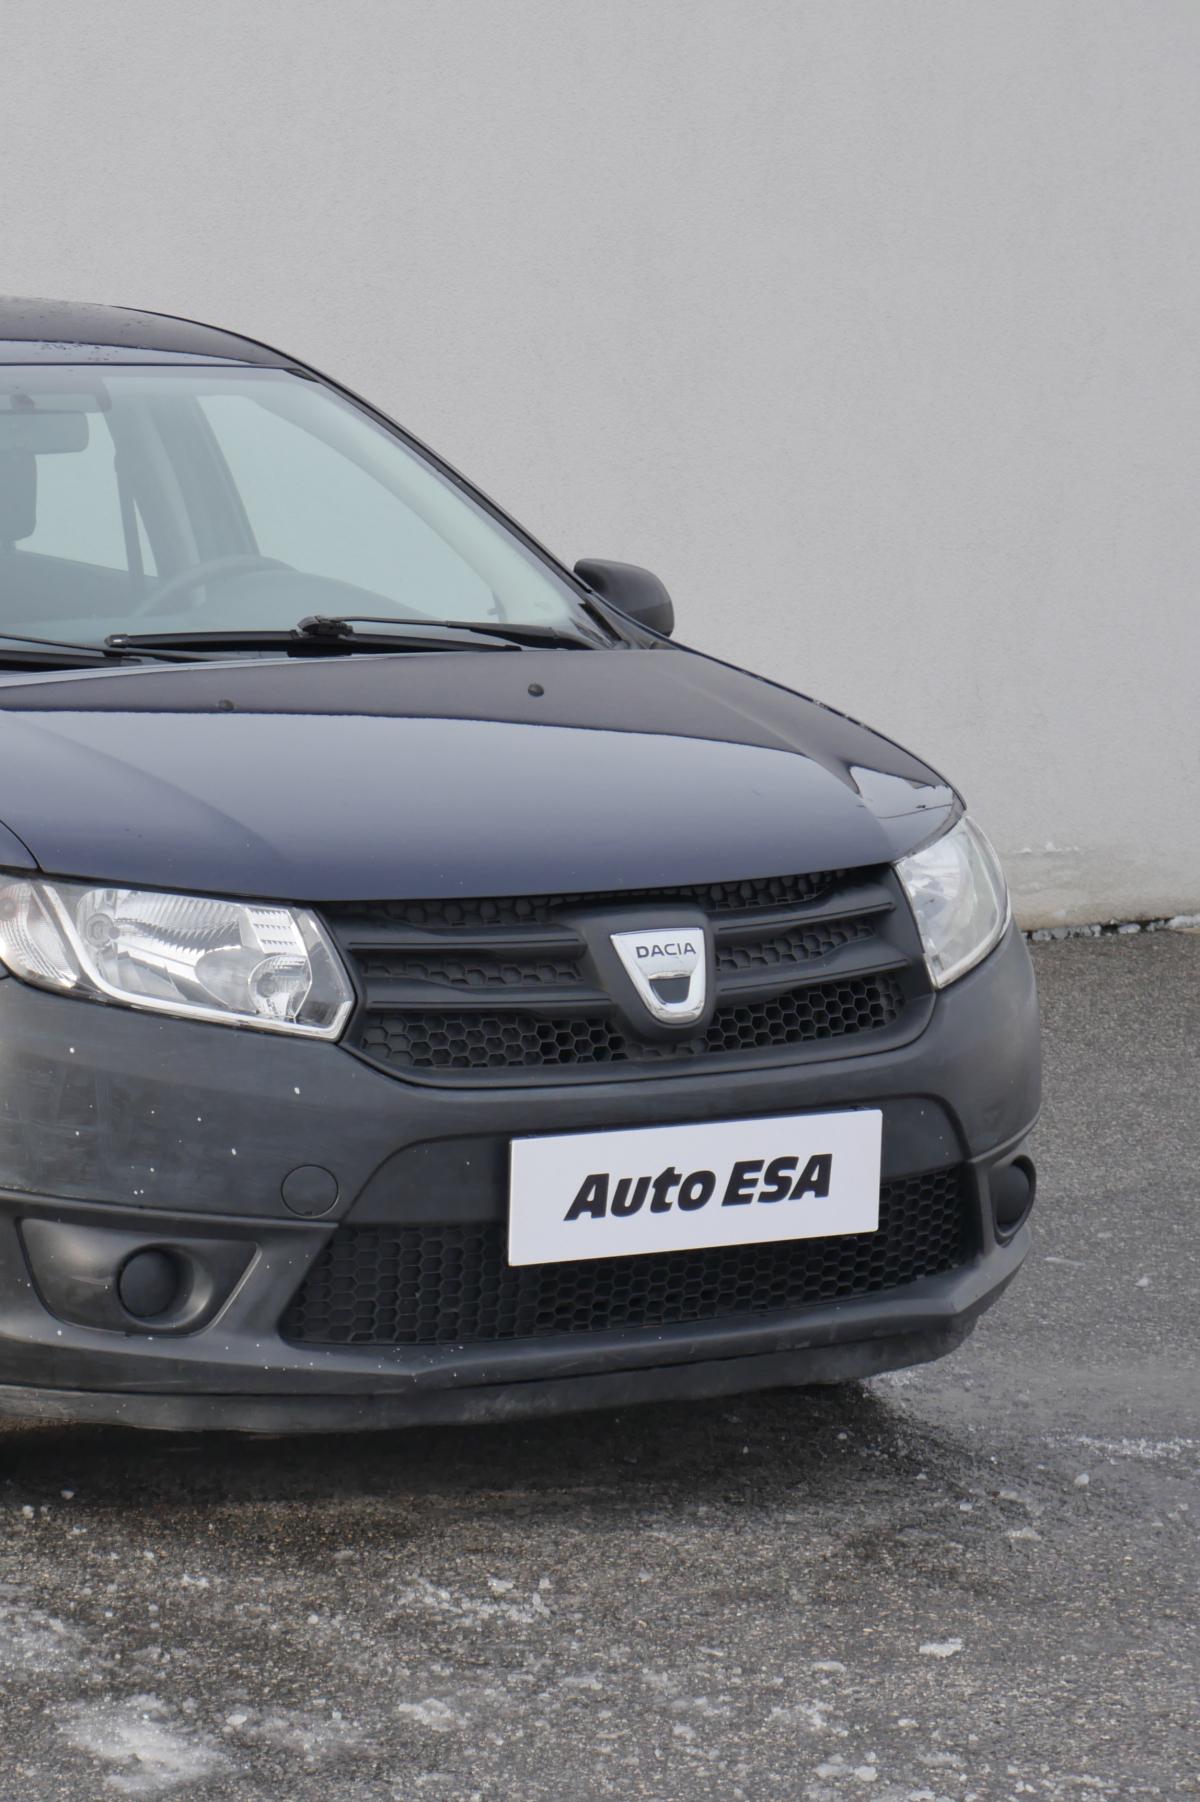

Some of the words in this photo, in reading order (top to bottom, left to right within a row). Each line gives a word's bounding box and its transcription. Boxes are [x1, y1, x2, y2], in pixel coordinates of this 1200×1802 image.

[636, 943, 696, 958] DACIA
[564, 1167, 716, 1221] Auto
[721, 1154, 832, 1206] ESA
